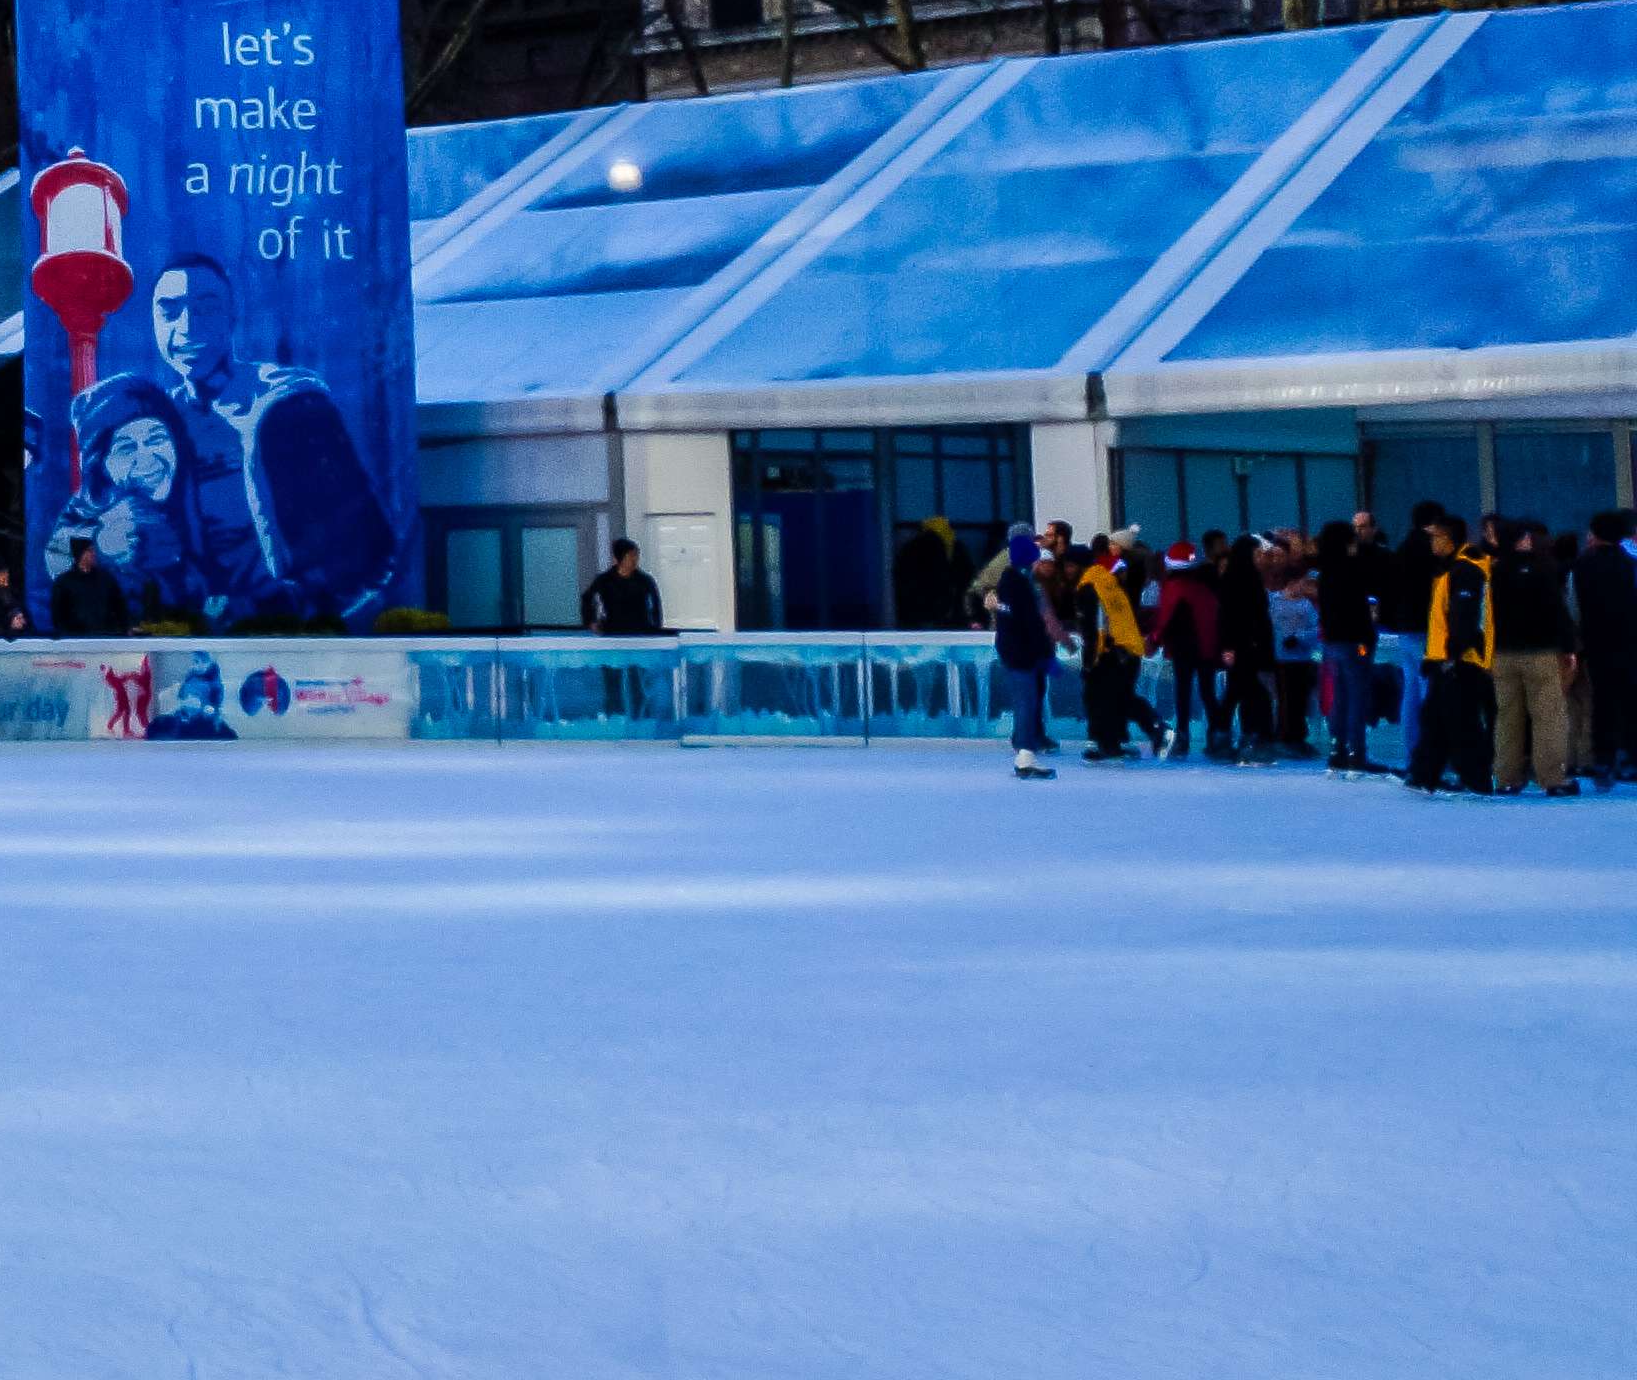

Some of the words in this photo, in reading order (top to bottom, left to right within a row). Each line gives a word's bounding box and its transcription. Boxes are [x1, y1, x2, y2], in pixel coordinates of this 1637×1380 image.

[221, 21, 315, 66] let's
[195, 85, 317, 130] make
[185, 162, 209, 195] a
[229, 150, 344, 207] night
[258, 215, 305, 260] of
[323, 218, 355, 260] it
[25, 694, 71, 727] day
